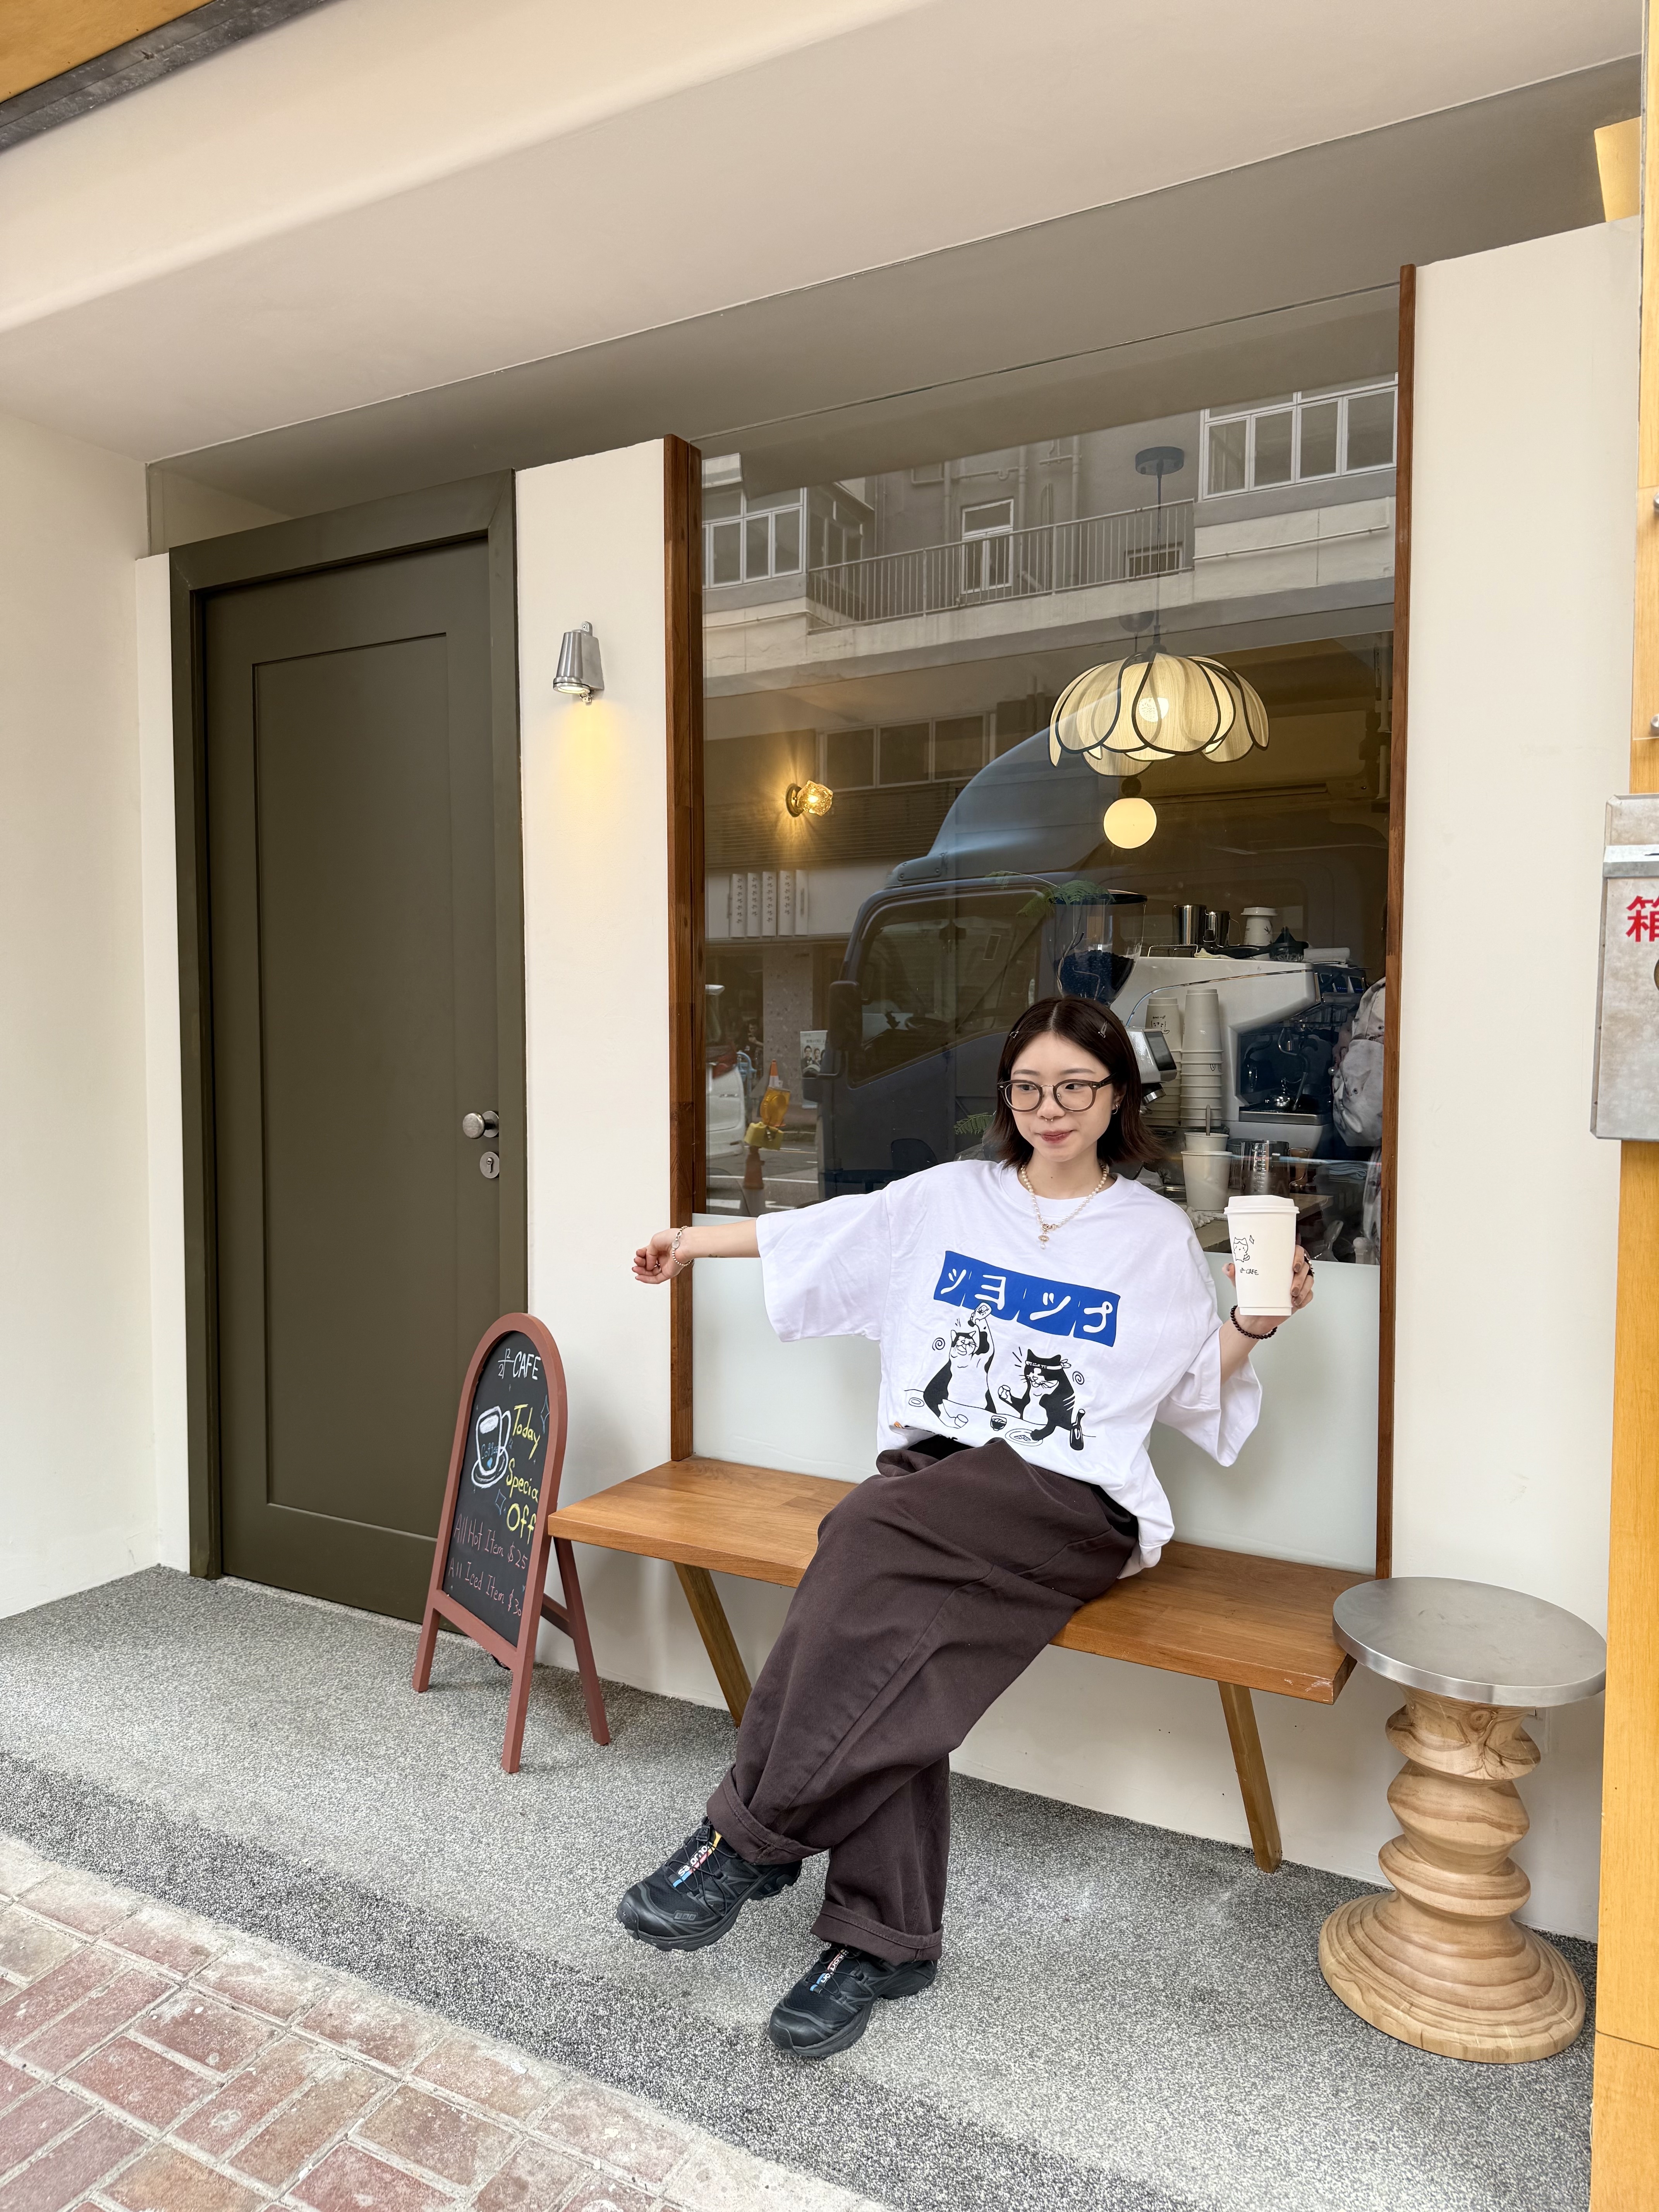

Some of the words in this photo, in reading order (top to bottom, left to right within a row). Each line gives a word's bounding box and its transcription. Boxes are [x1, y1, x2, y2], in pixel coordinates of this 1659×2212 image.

[513, 1351, 541, 1381] CAFE
[512, 1403, 541, 1460] Today
[453, 1513, 468, 1544] All
[468, 1518, 483, 1551] Hot
[484, 1529, 504, 1557] Item
[508, 1541, 528, 1569] $25
[506, 1503, 537, 1545] Off
[448, 1557, 462, 1579] All
[464, 1561, 484, 1590] Iced
[486, 1574, 505, 1604] Item
[508, 1589, 522, 1616] $30
[677, 1842, 712, 1877] saomo
